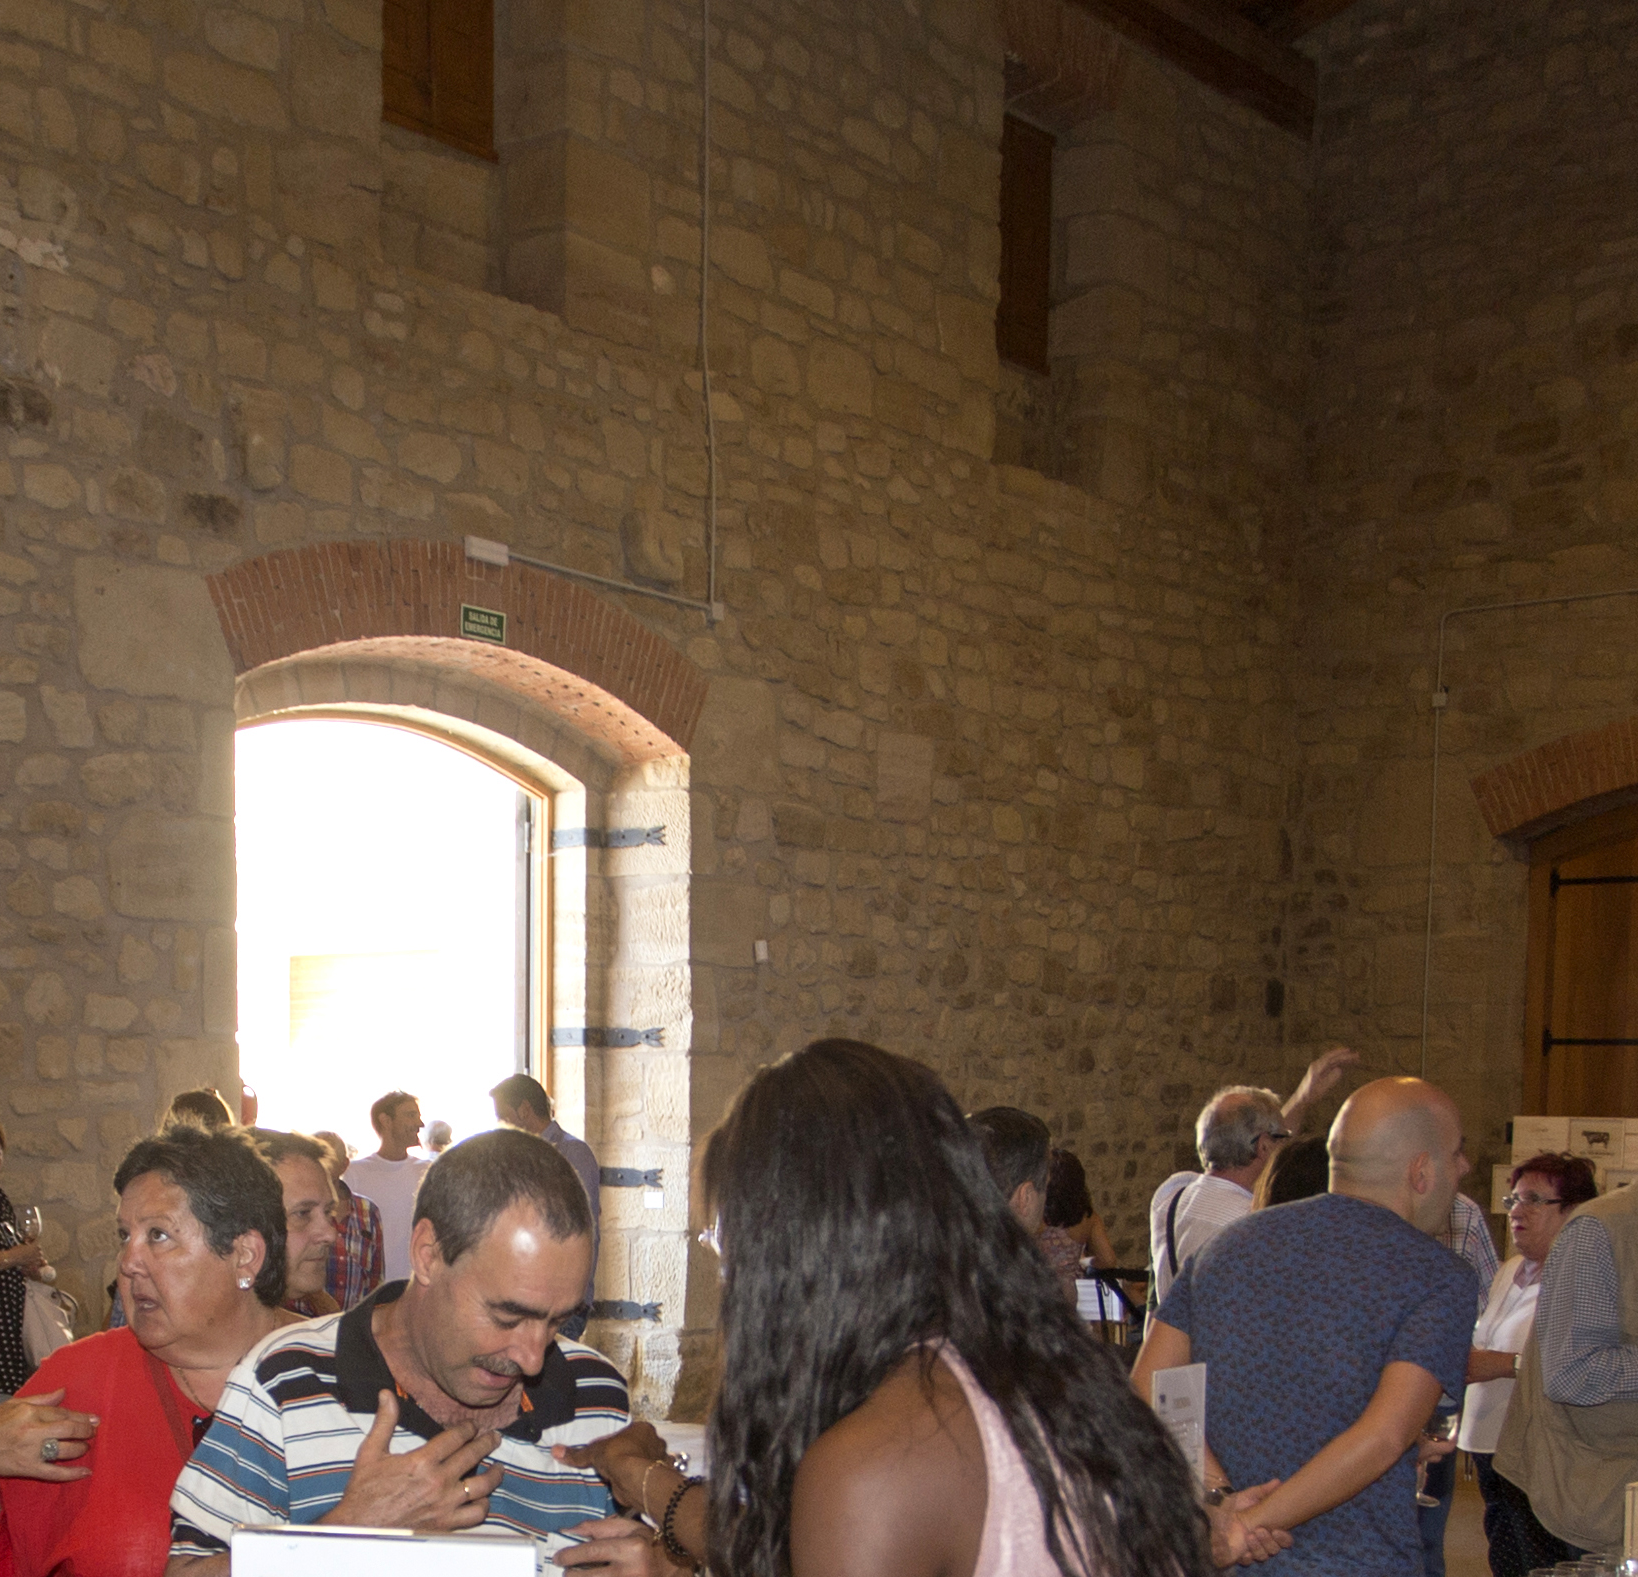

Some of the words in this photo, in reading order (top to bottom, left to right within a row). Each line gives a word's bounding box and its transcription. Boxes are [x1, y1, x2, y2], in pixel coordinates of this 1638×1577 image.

[468, 611, 489, 624] SALIDA
[490, 616, 498, 627] DE
[465, 621, 501, 638] EMERGENCIA
